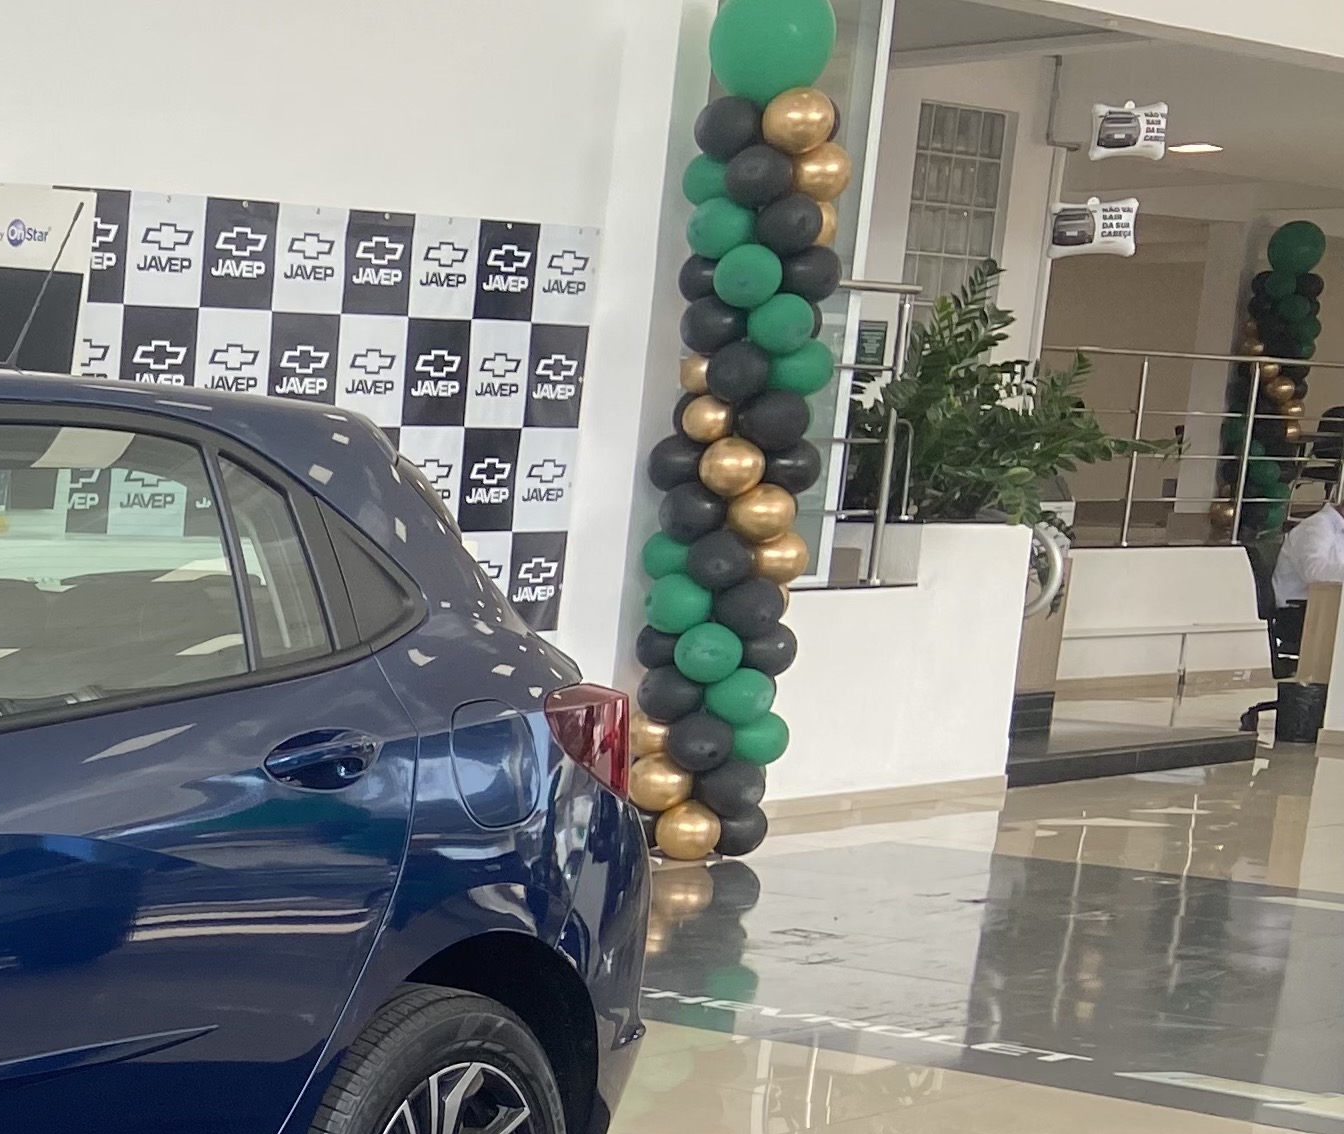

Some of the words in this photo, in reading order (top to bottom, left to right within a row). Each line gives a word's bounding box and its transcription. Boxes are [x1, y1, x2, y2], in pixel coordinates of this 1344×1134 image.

[137, 255, 192, 273] JAVEP
[211, 259, 266, 278] JAVEP
[284, 264, 334, 281] JAVEP
[352, 268, 403, 286] JAVEP
[420, 272, 467, 288] JAVEP
[483, 274, 529, 292] JAVEP
[542, 279, 586, 295] JAVEP
[205, 376, 258, 392] JAVEP
[275, 376, 328, 395] JAVEP
[345, 379, 394, 395] JAVEP
[411, 380, 460, 398] JAVEP
[475, 382, 519, 397] JAVEP
[532, 383, 576, 400] JAVEP
[120, 493, 175, 509] JAVEP
[465, 488, 509, 504] JAVEP
[522, 488, 564, 502] JAVEP
[512, 585, 555, 603] JAVEP
